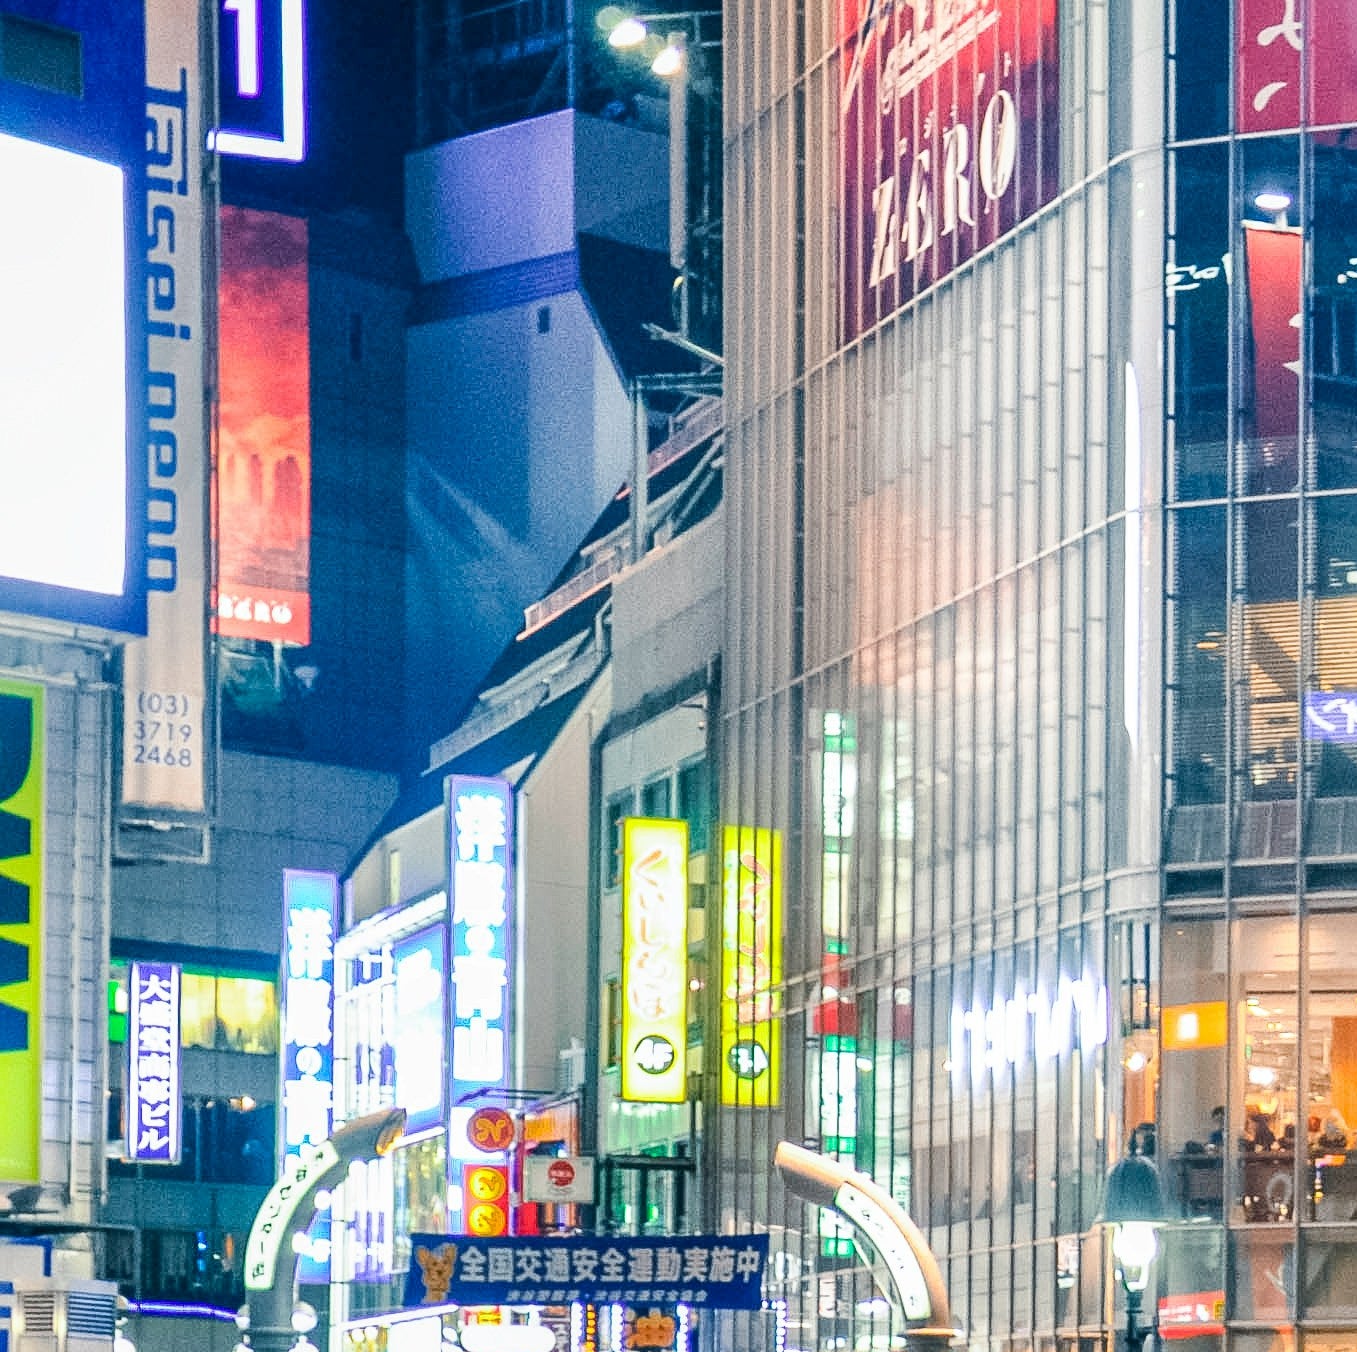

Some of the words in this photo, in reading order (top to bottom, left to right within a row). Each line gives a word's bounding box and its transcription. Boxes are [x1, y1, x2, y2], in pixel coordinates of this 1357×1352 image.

[869, 88, 1018, 290] ZERO
[137, 691, 190, 718] (03)
[132, 720, 193, 744] 3719
[132, 745, 193, 769] 2468
[459, 1245, 762, 1284] 全国交通安全運動実施中
